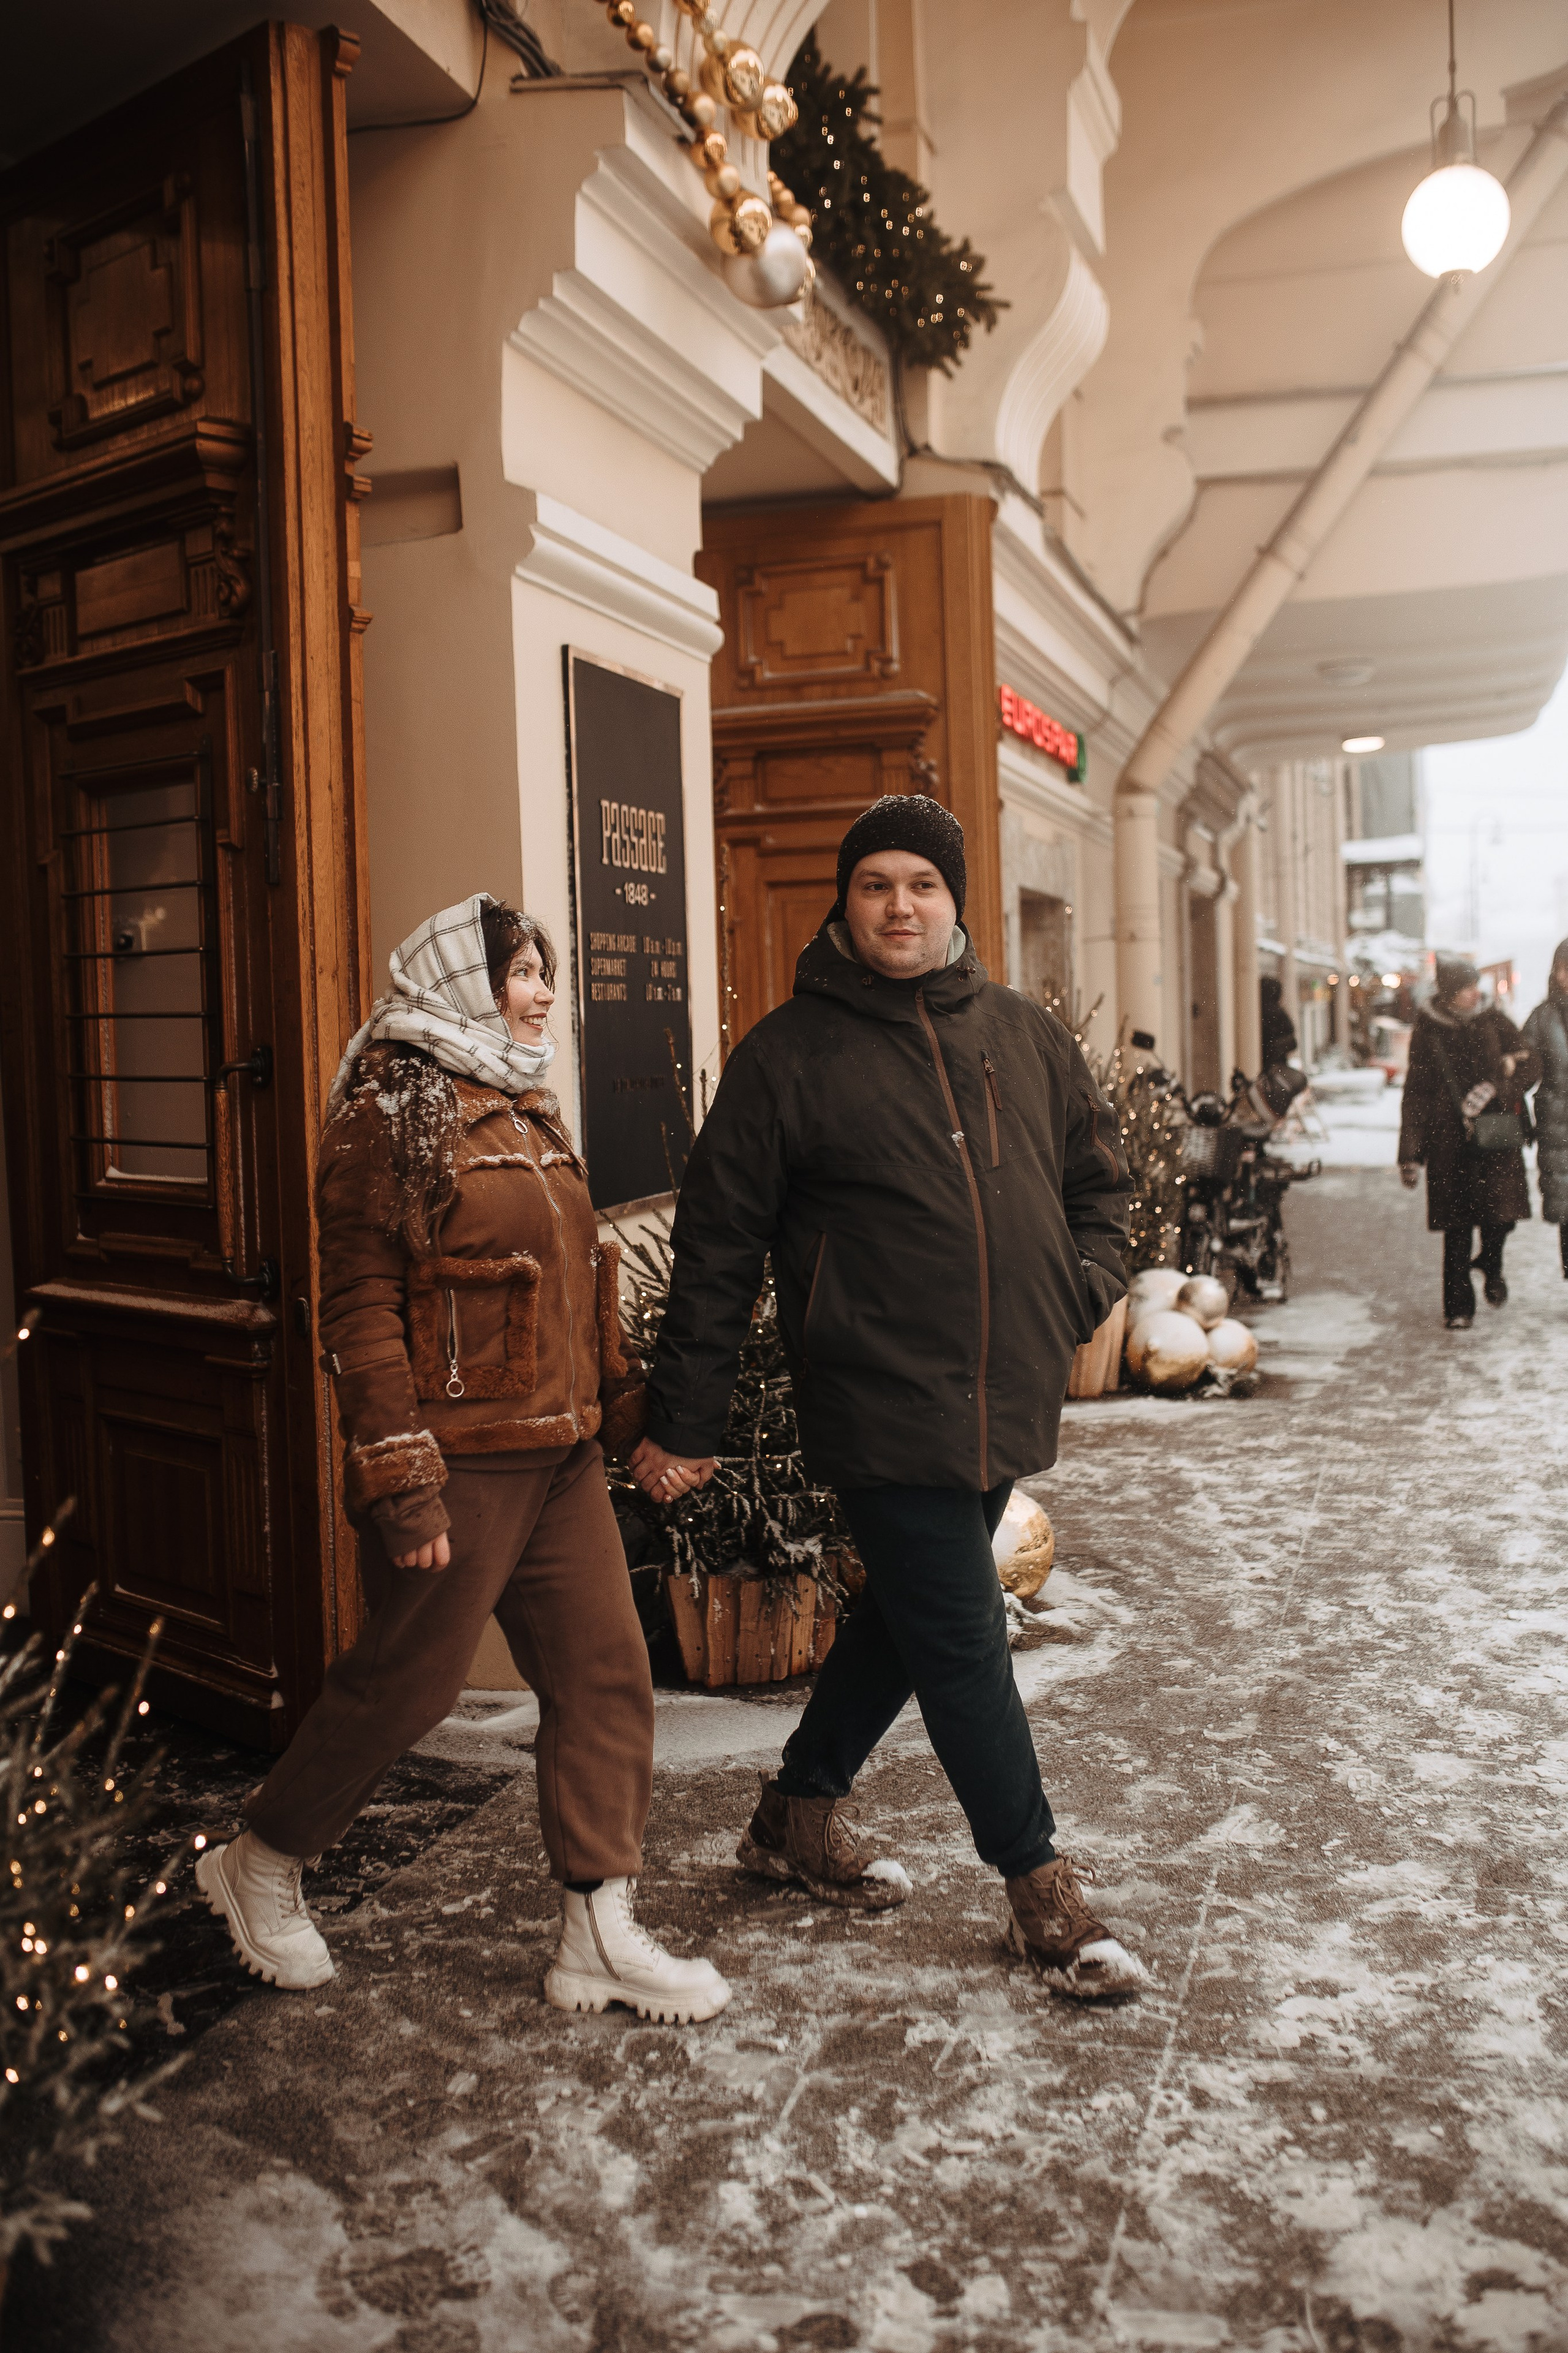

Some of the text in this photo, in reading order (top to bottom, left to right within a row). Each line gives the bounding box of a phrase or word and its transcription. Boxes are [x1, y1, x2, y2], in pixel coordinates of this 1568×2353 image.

[624, 882, 649, 907] 1848
[590, 931, 616, 951] SHOPPING
[590, 957, 627, 977] SUPERMARKET
